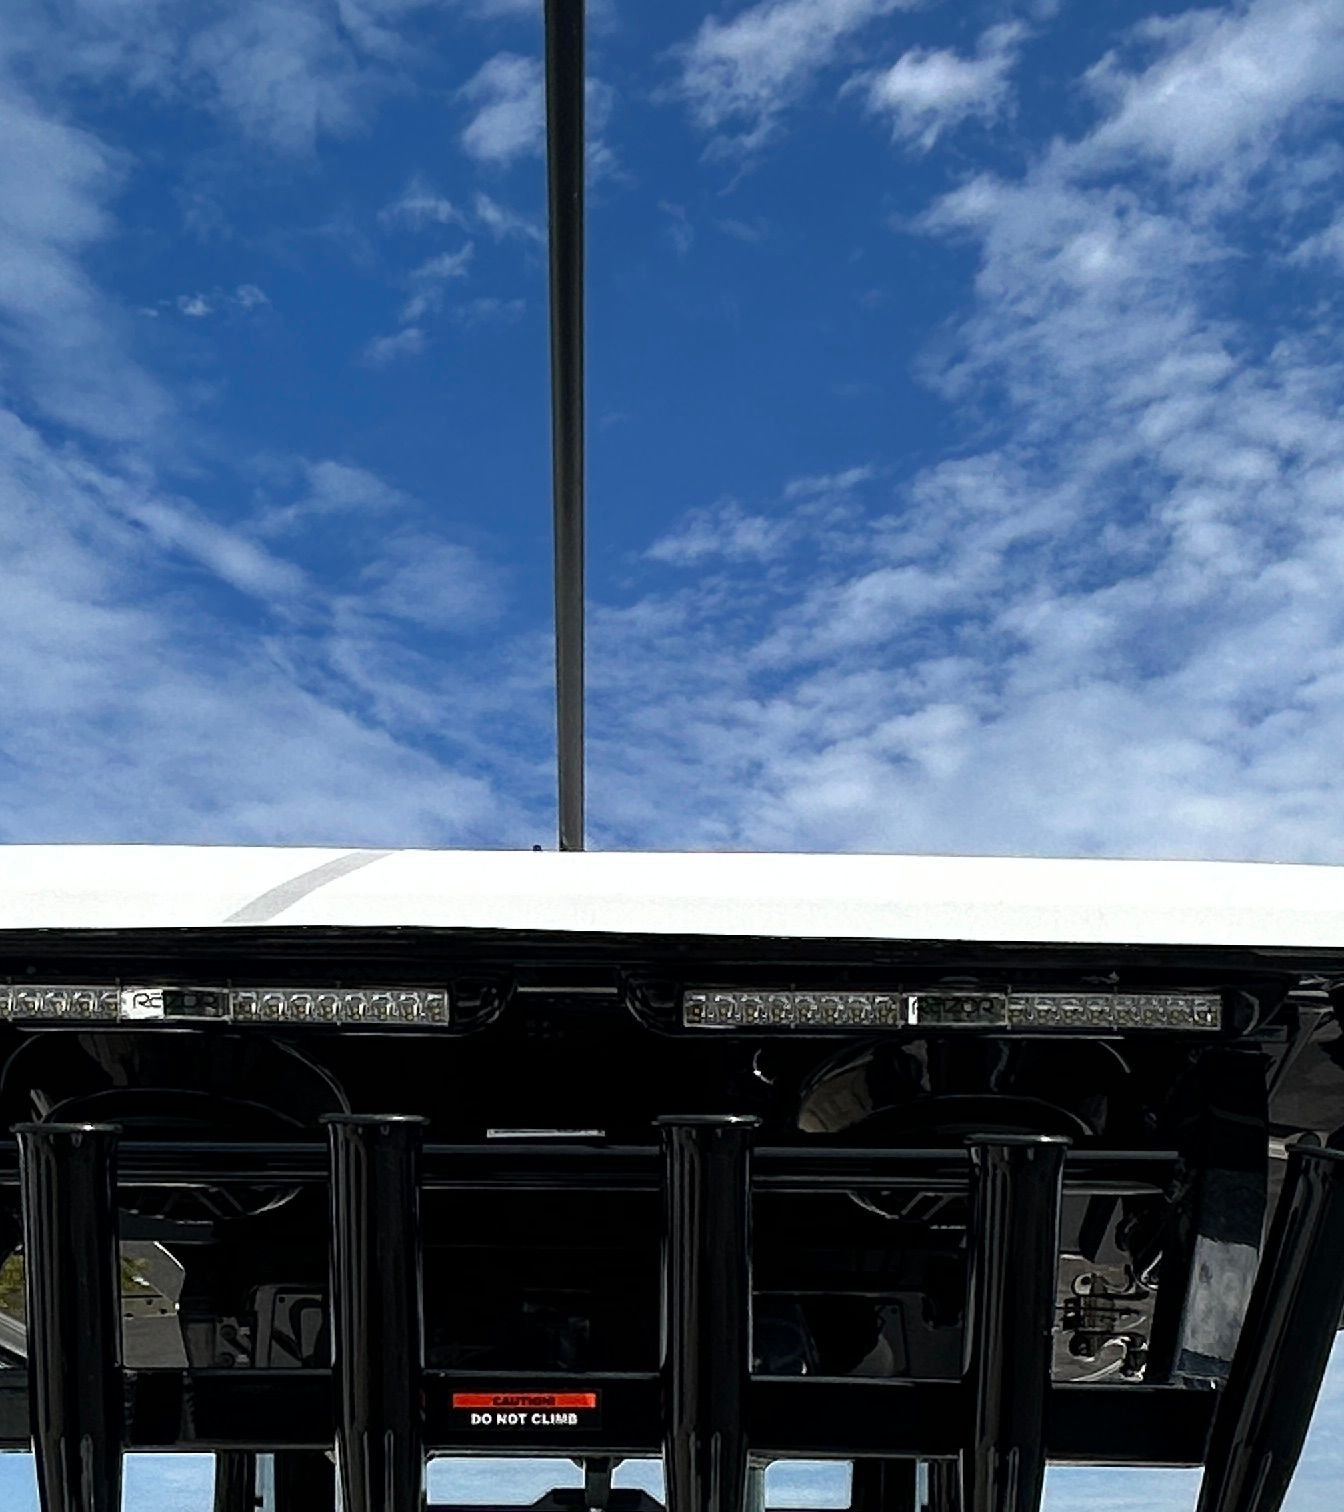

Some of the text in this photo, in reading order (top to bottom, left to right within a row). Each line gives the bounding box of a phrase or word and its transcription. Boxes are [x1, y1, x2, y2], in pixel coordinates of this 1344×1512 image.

[470, 1413, 578, 1426] DO NOT CLIMB
